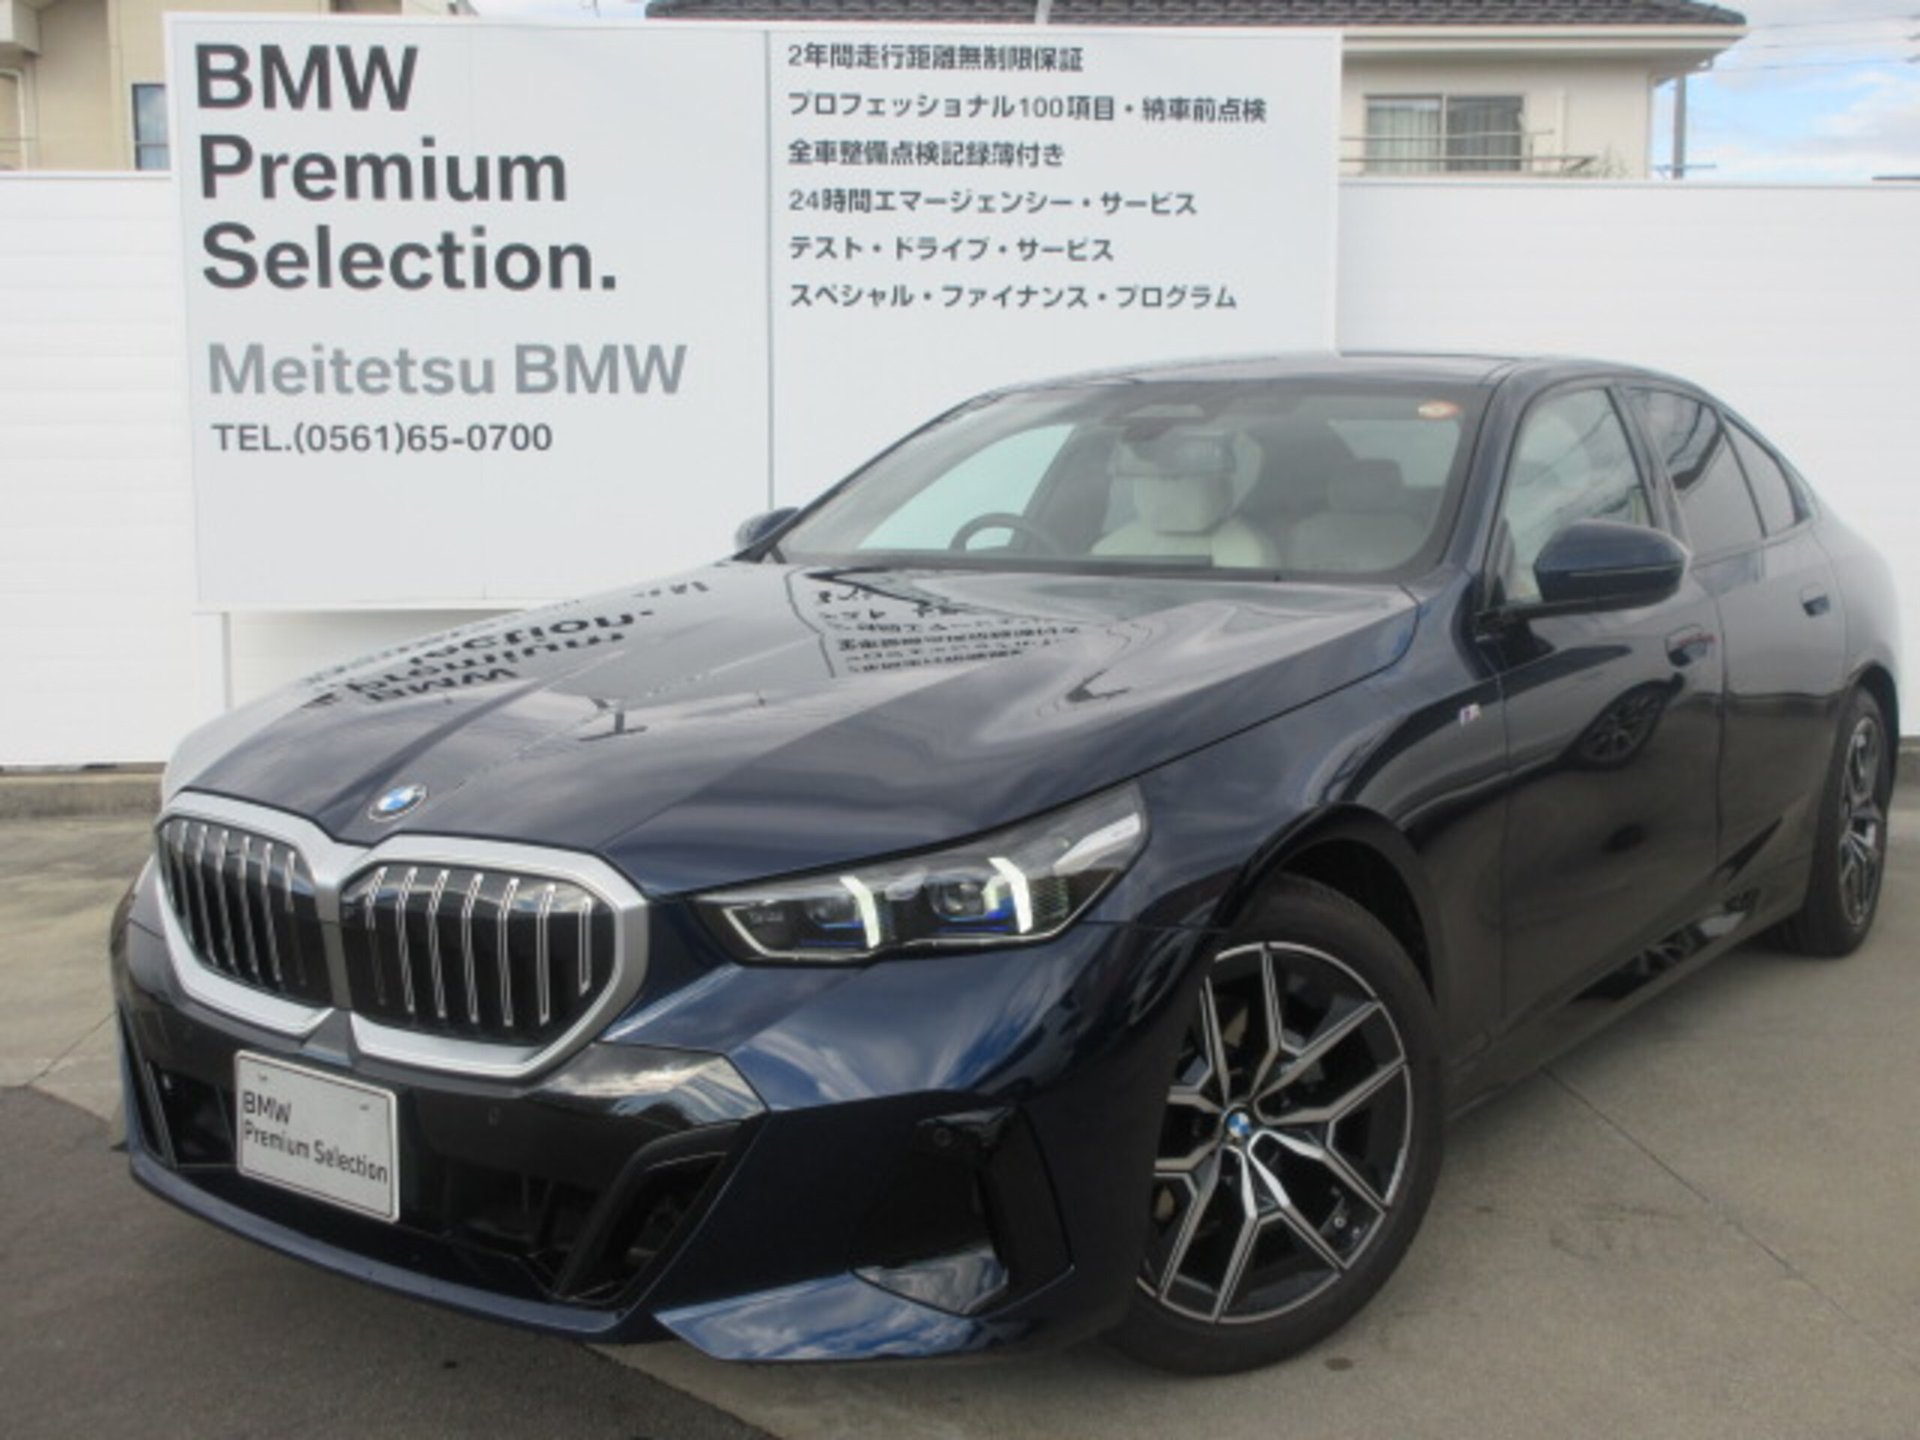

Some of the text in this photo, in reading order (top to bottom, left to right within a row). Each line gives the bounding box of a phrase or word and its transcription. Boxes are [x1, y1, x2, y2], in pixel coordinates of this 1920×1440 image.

[788, 42, 1084, 72] 2年間走行距離無制限保証
[195, 43, 418, 111] BMW
[788, 92, 1267, 124] プロフェッショナル100項目・納車前点検
[200, 134, 566, 202] Premium
[788, 138, 1065, 168] 全車整備点検記録簿付き
[789, 187, 1198, 216] 24時間エマージェンシー・サービス
[203, 221, 616, 291] Selection.
[789, 235, 1114, 262] テスト・ドライブ・サービス
[790, 283, 1237, 310] スペシャル・ファイナンス・プログラム
[209, 342, 687, 396] Meitetsu BMW
[210, 421, 553, 455] TEL.(0561)65-0700
[243, 1091, 291, 1124] BMW
[244, 1119, 388, 1184] Premium Selection
